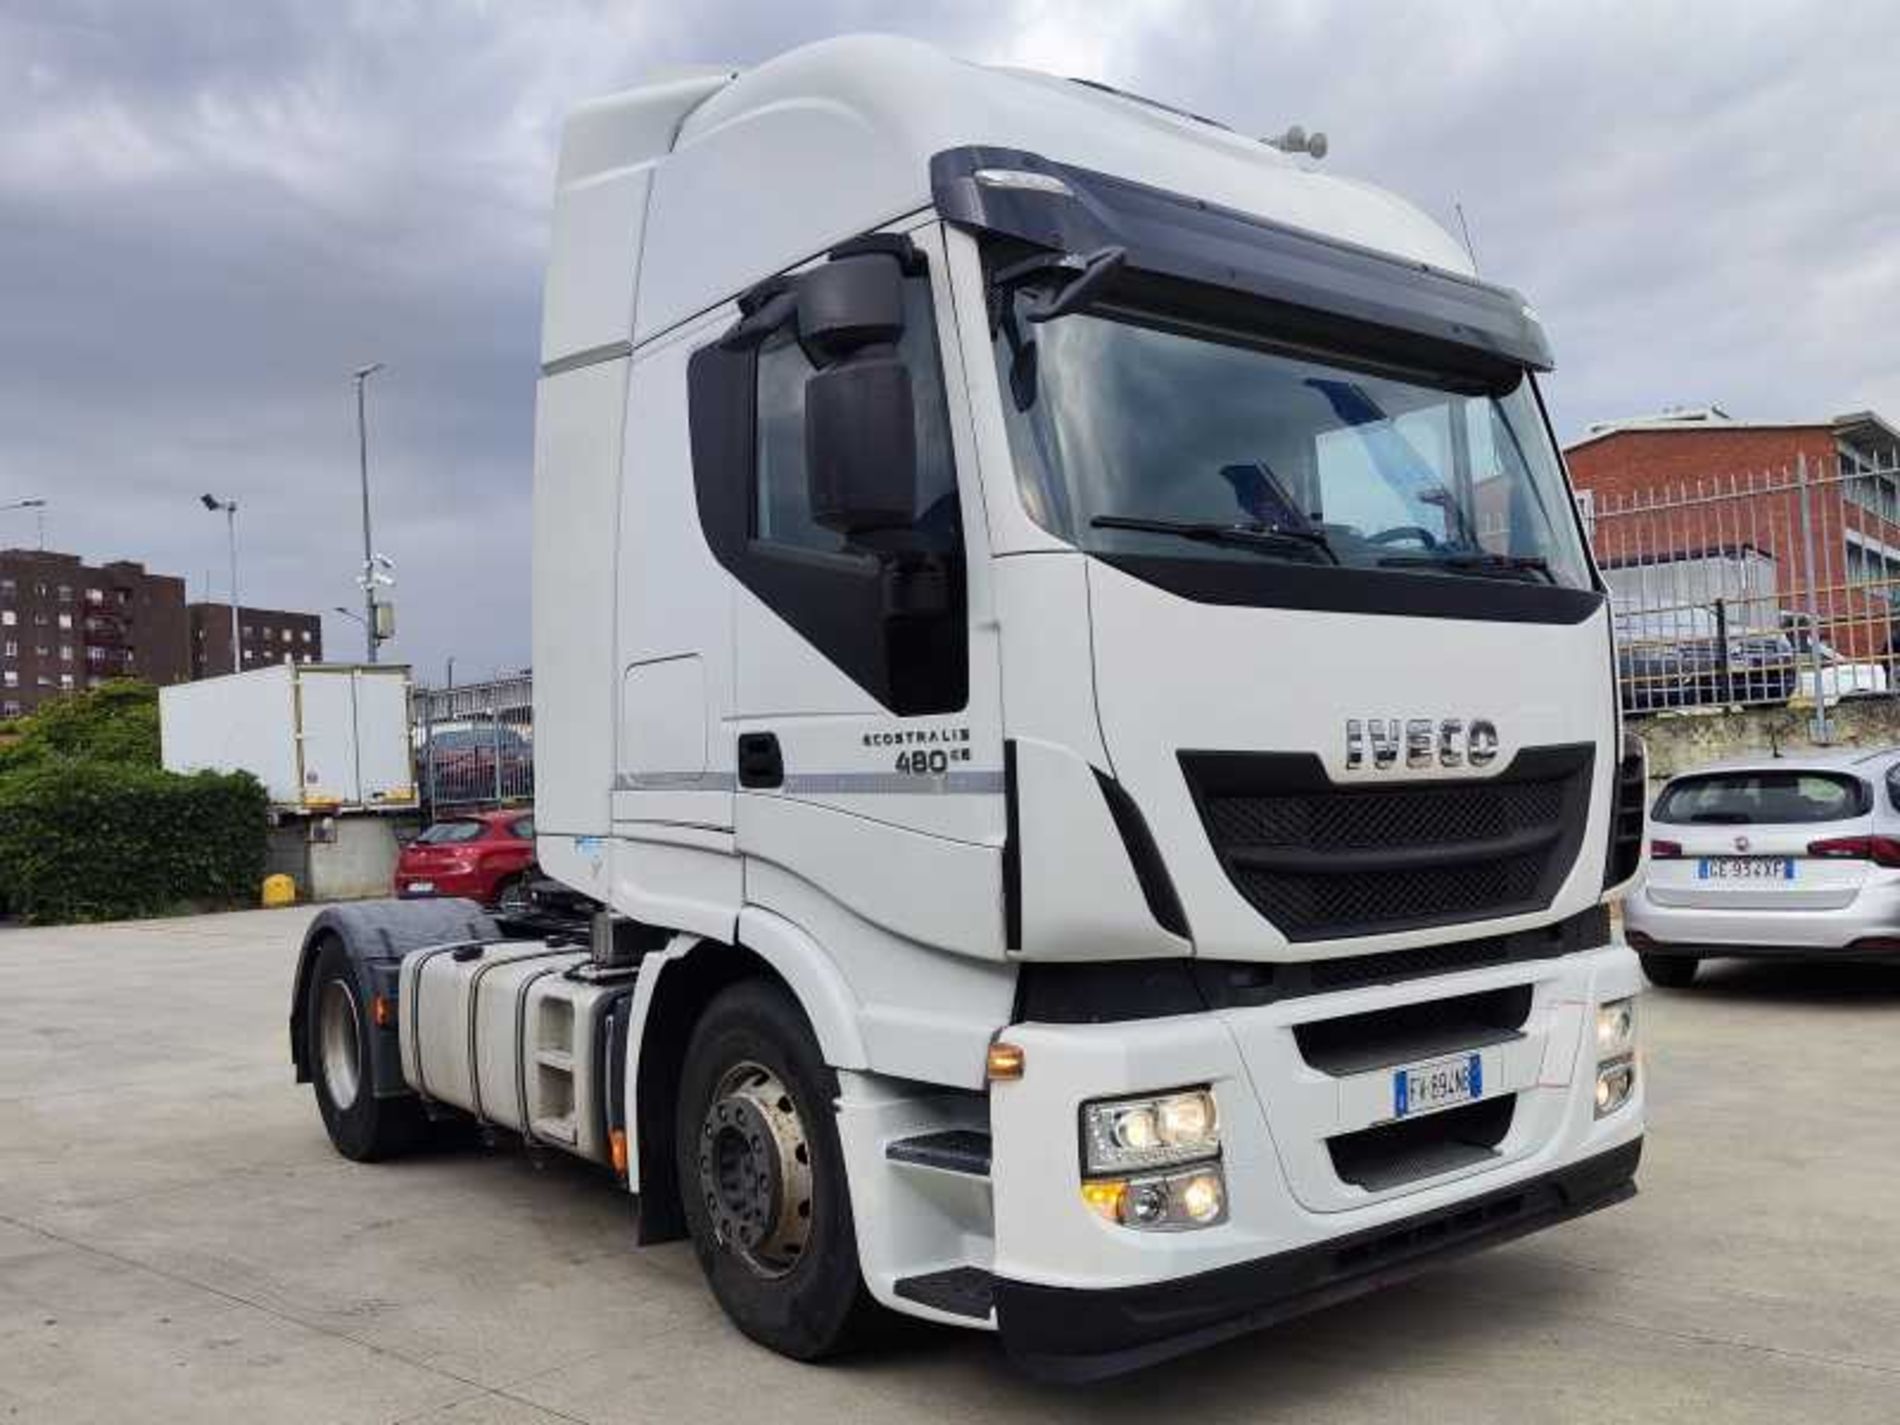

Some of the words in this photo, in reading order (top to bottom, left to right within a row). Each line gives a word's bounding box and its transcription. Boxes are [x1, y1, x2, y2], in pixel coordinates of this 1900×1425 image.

[862, 728, 970, 747] ECOSTRALIS
[1346, 718, 1499, 771] IVECO
[894, 749, 949, 775] 480
